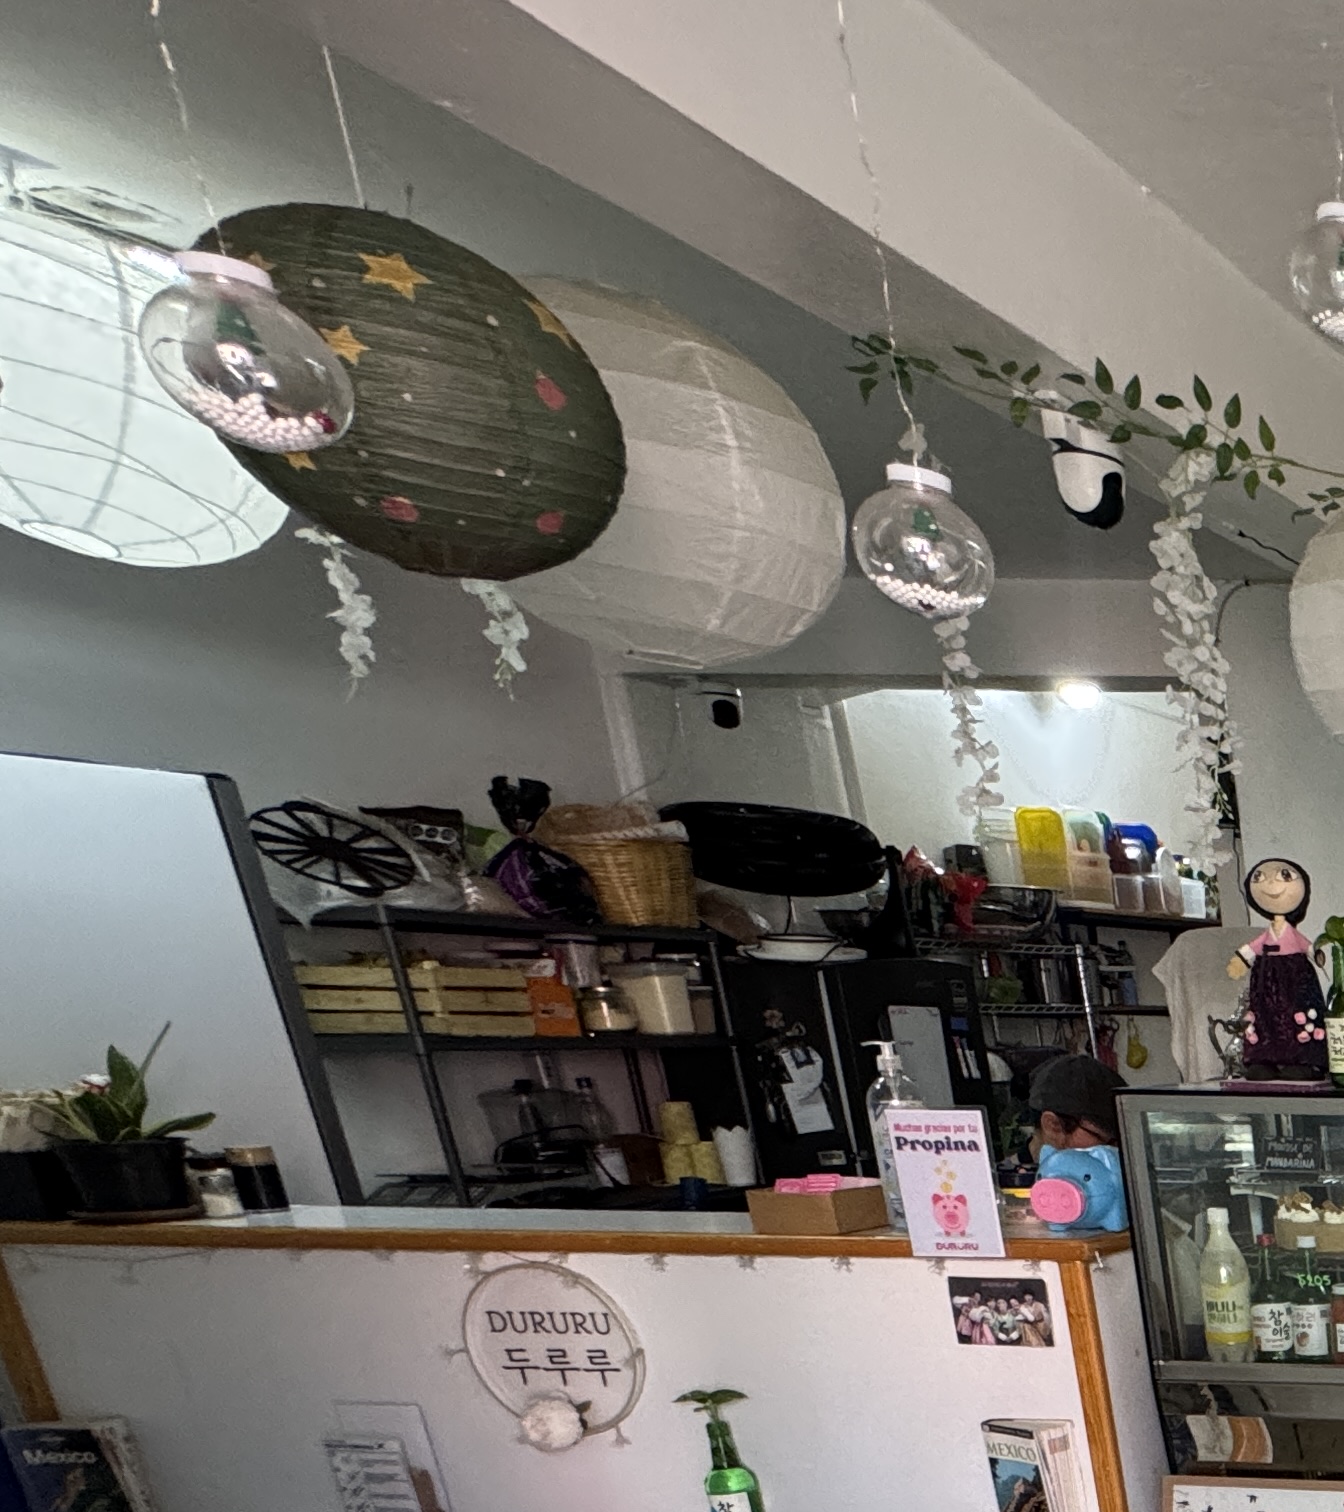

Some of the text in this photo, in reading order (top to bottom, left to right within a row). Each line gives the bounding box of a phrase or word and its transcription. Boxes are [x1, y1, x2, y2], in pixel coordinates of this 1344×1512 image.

[895, 1136, 981, 1155] Propina
[485, 1310, 612, 1336] DURURU
[502, 1348, 622, 1388] 두루루
[987, 1442, 1037, 1462] MEXICO
